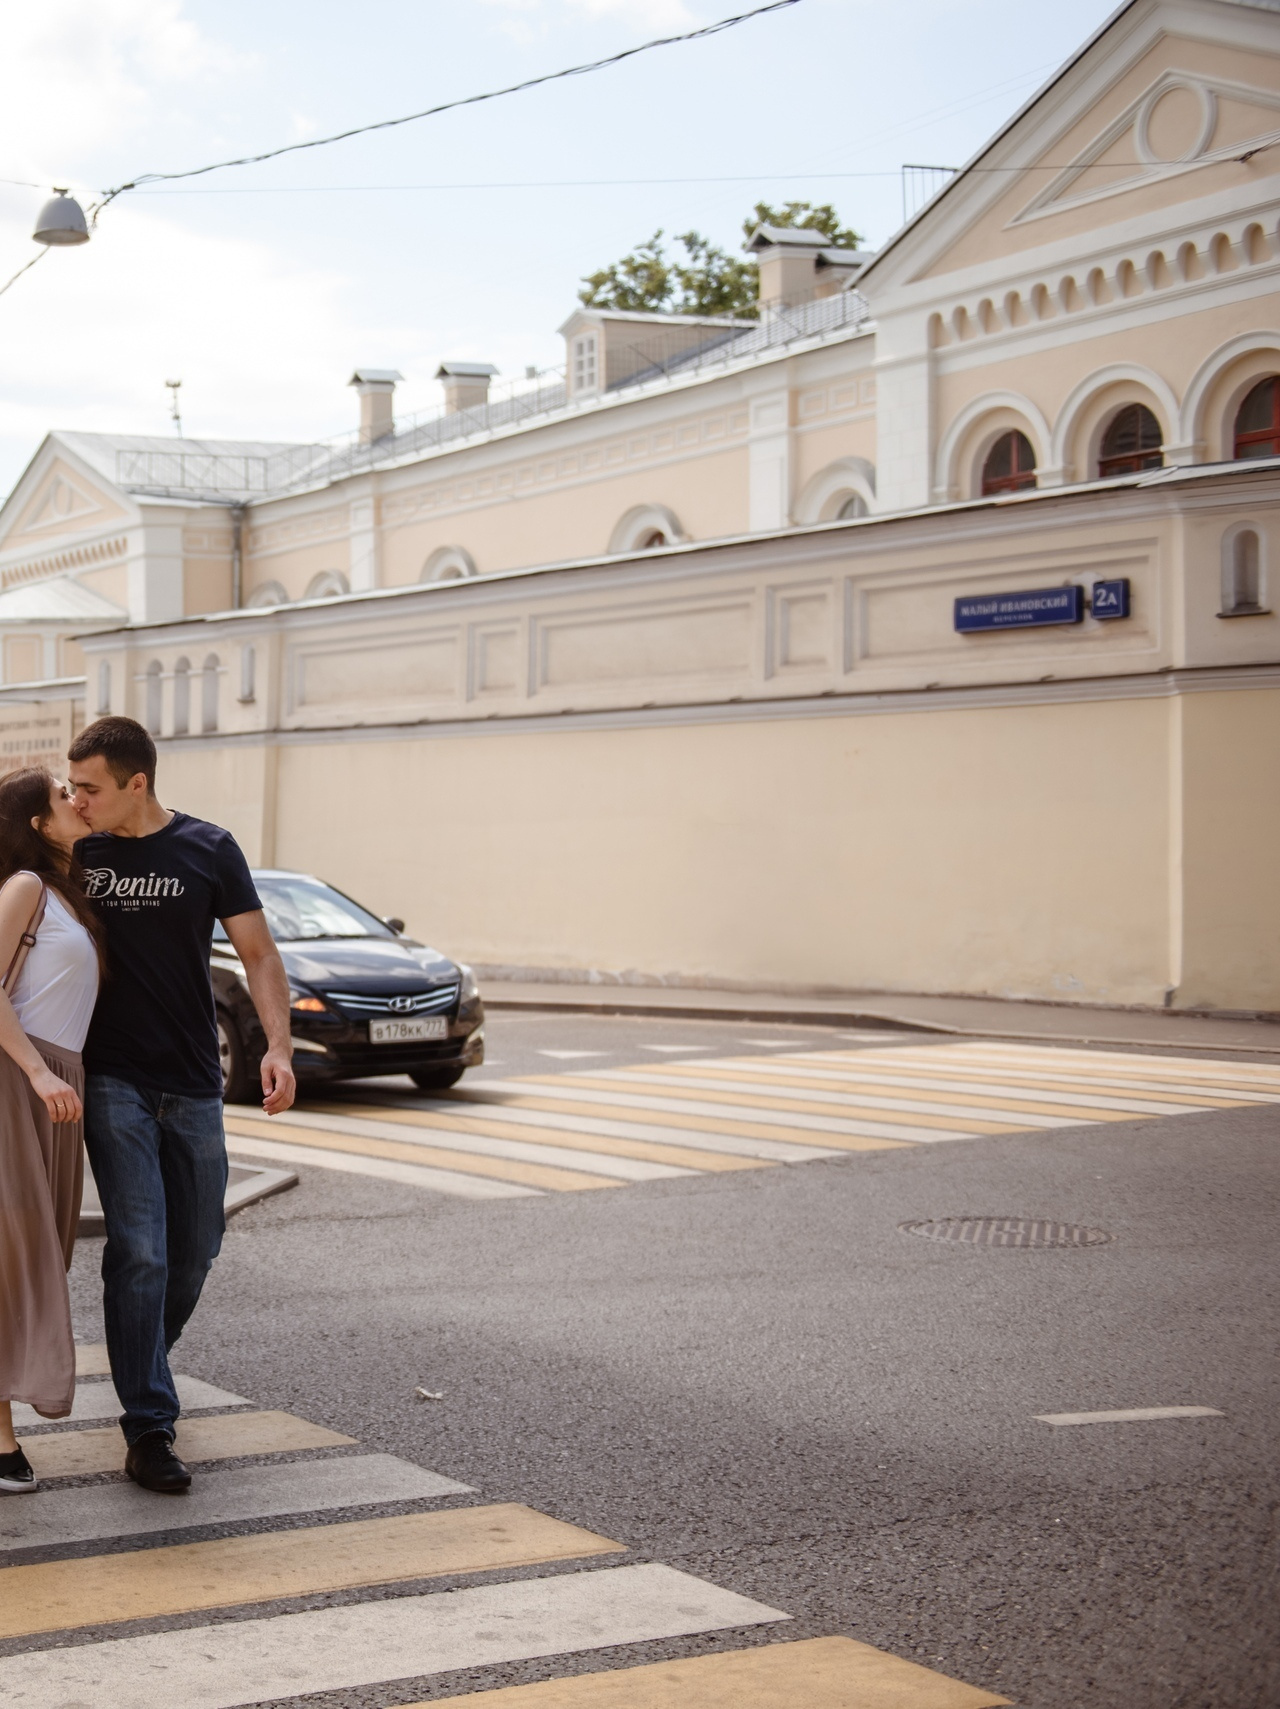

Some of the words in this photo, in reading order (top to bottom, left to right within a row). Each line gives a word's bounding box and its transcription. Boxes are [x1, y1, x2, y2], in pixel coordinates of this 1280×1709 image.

[961, 602, 998, 617] МАЛЫЙ
[999, 594, 1069, 614] ИВАНОВСКИЙ
[81, 867, 185, 899] Denim
